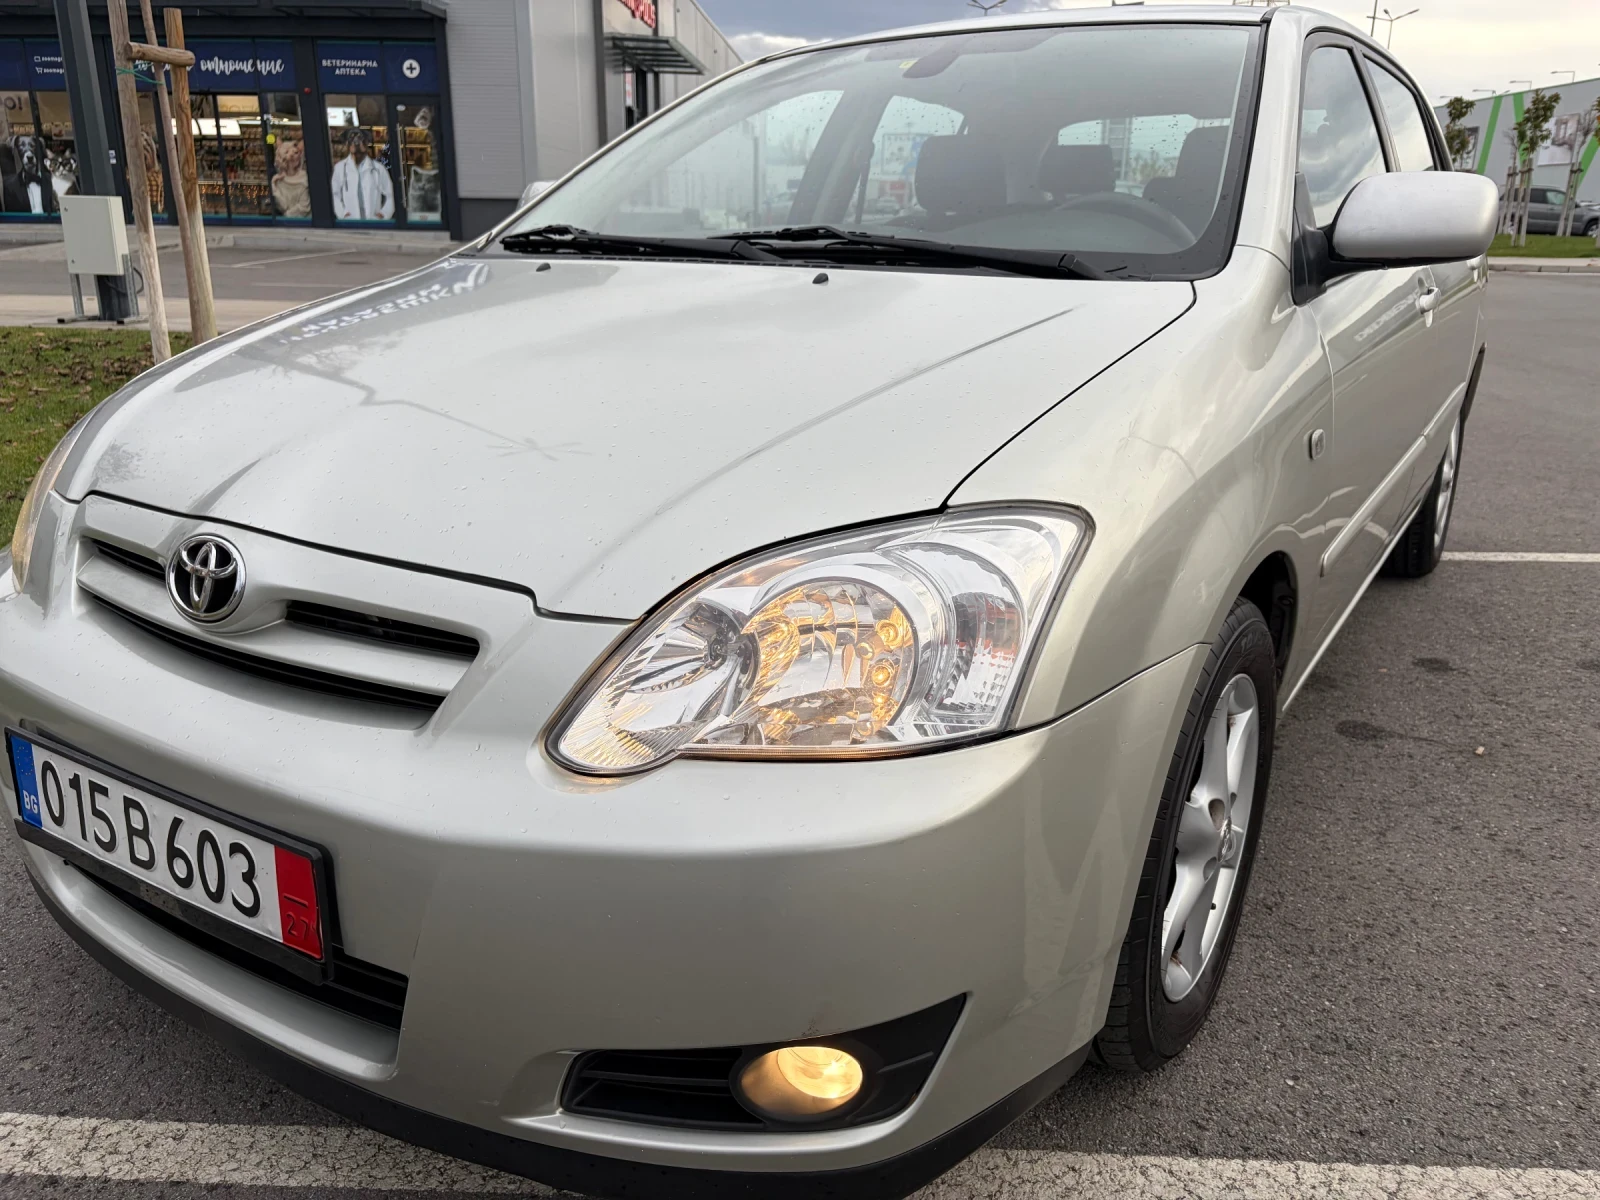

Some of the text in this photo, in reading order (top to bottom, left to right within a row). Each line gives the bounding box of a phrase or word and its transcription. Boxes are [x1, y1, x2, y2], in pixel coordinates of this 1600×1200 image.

[321, 58, 378, 68] ВЕТЕРИНАРНА
[334, 67, 367, 76] АПТЕКА
[22, 788, 39, 816] BG
[286, 911, 309, 940] 27
